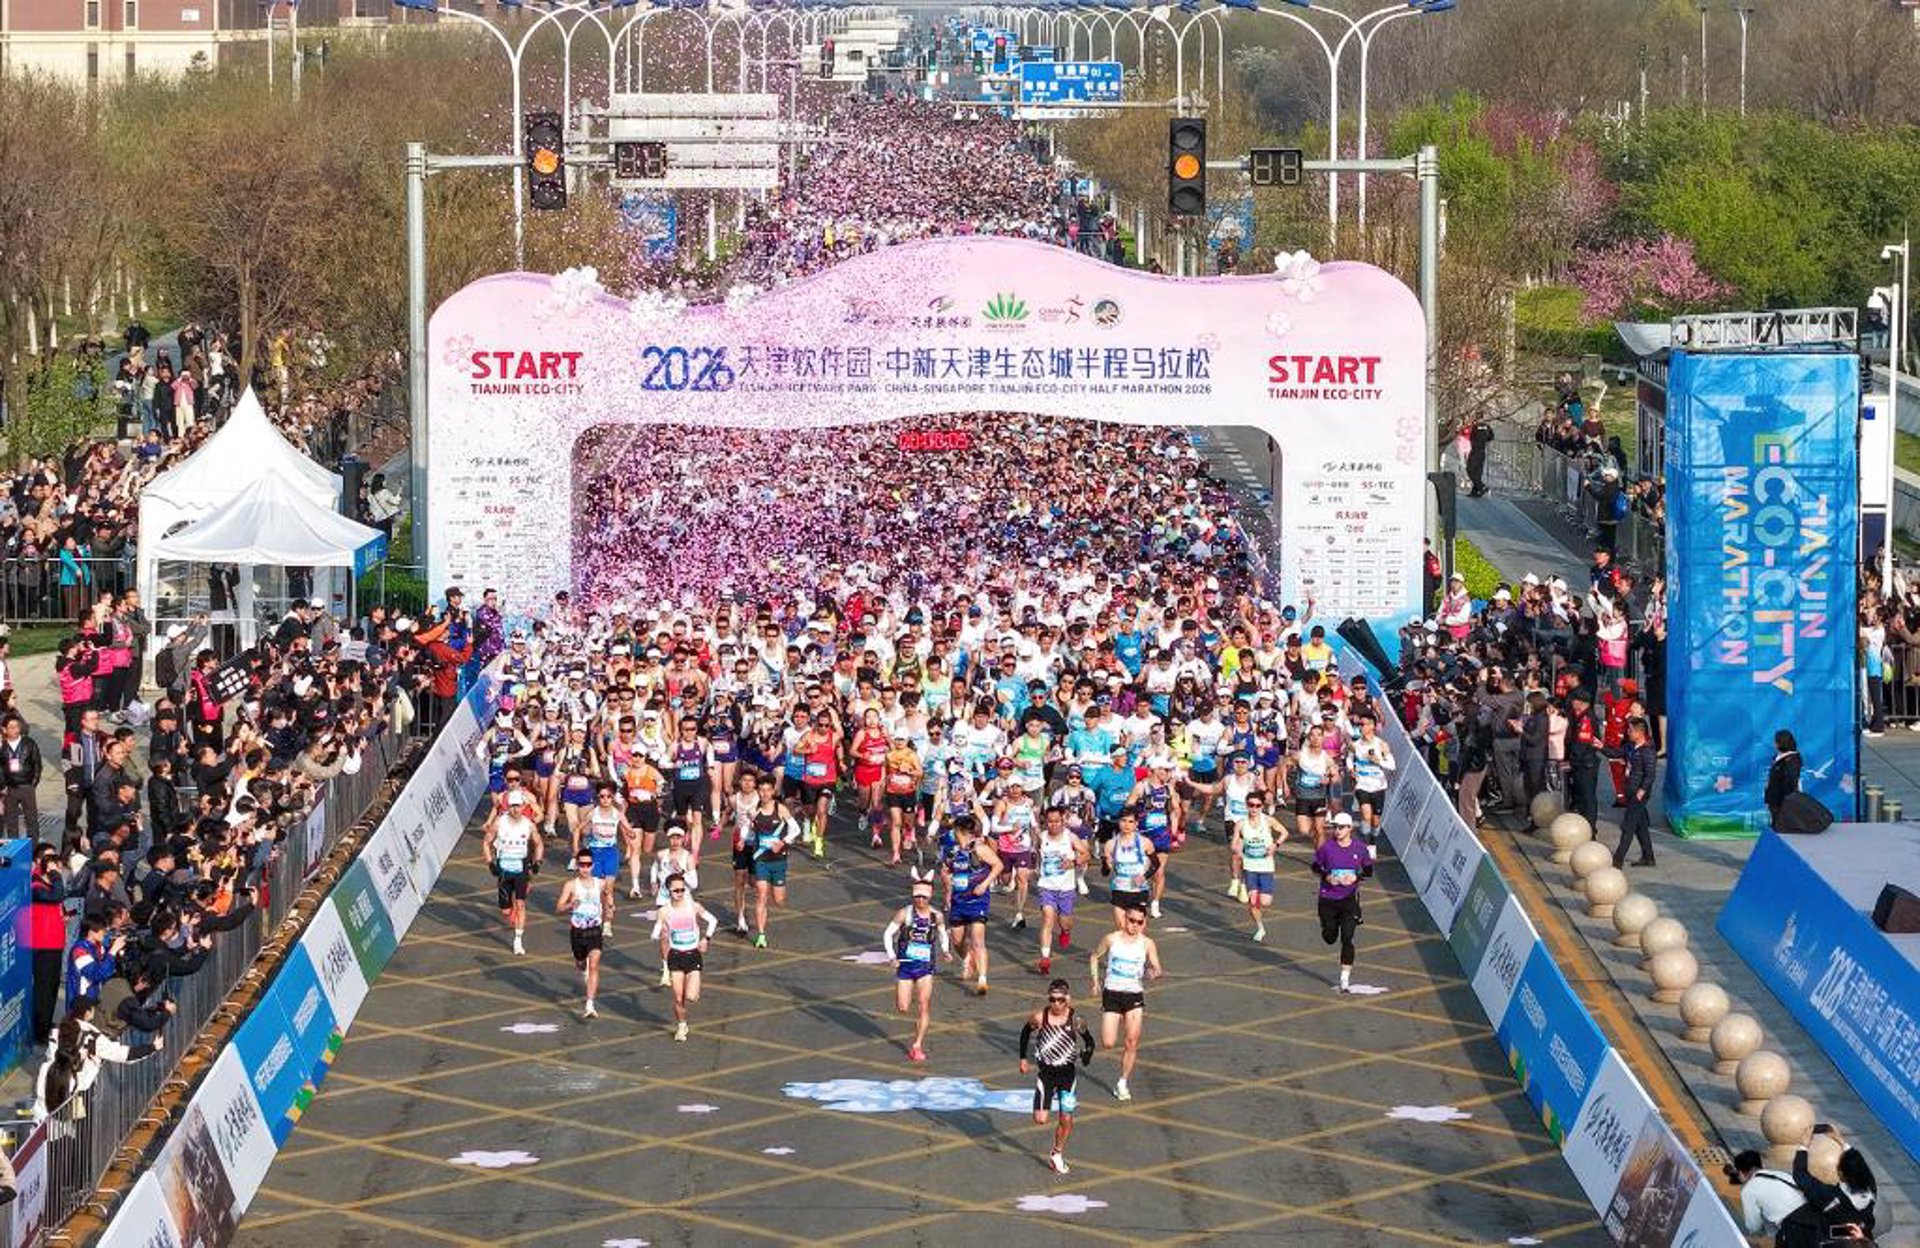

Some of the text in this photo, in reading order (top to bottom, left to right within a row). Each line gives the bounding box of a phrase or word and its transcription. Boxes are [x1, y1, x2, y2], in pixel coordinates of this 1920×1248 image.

[471, 351, 584, 379] START
[641, 346, 735, 392] 2026
[1268, 355, 1381, 384] START
[470, 383, 521, 395] TIANJIN
[884, 383, 985, 394] CHINA-SINGAPORE
[989, 383, 1034, 394] TIANJIN
[1089, 384, 1118, 394] HALF
[1121, 384, 1182, 394] MARATHON
[1184, 384, 1212, 394] 2026
[1268, 387, 1319, 400] TIANJIN
[1722, 465, 1749, 665] MARATHON
[1753, 433, 1796, 697] ECO-CITY
[1800, 494, 1828, 638] TIANJIN
